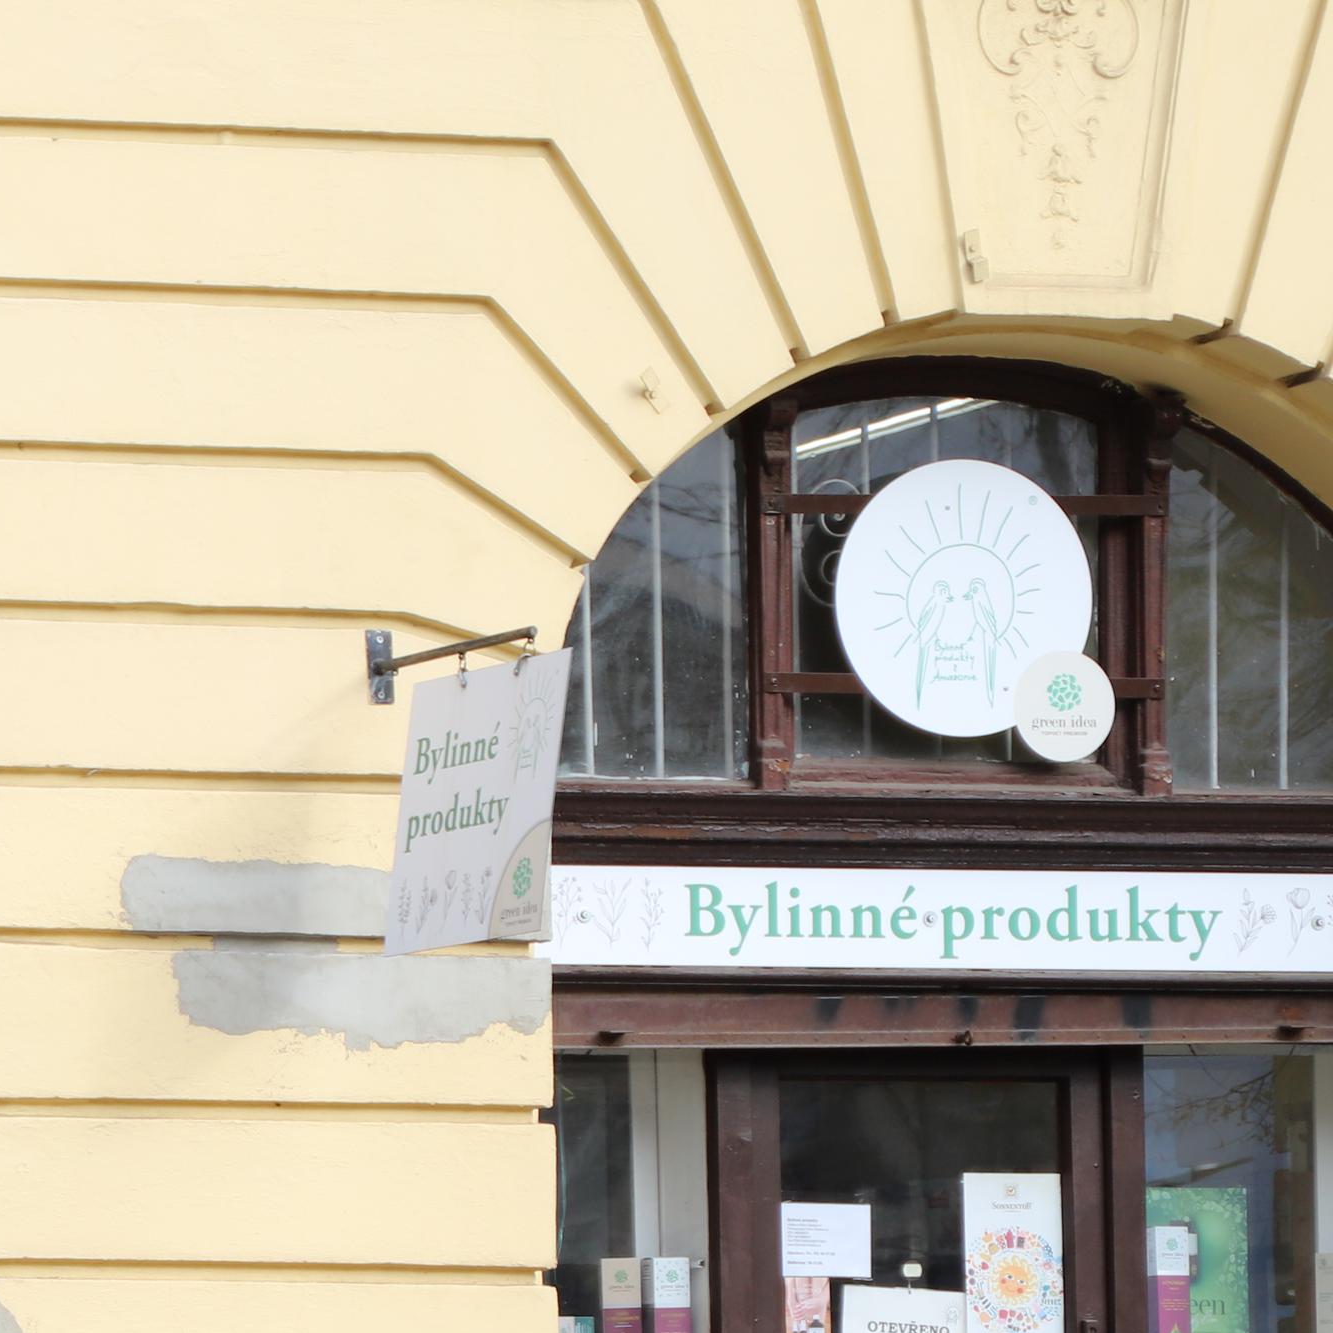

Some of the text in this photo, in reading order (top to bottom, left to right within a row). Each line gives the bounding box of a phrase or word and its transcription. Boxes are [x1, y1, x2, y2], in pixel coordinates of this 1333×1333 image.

[413, 721, 501, 784] Bylinné
[1031, 715, 1097, 729] green idea
[404, 787, 509, 853] produkty
[684, 881, 1223, 961] Bylinné produkty
[1190, 1299, 1226, 1316] een
